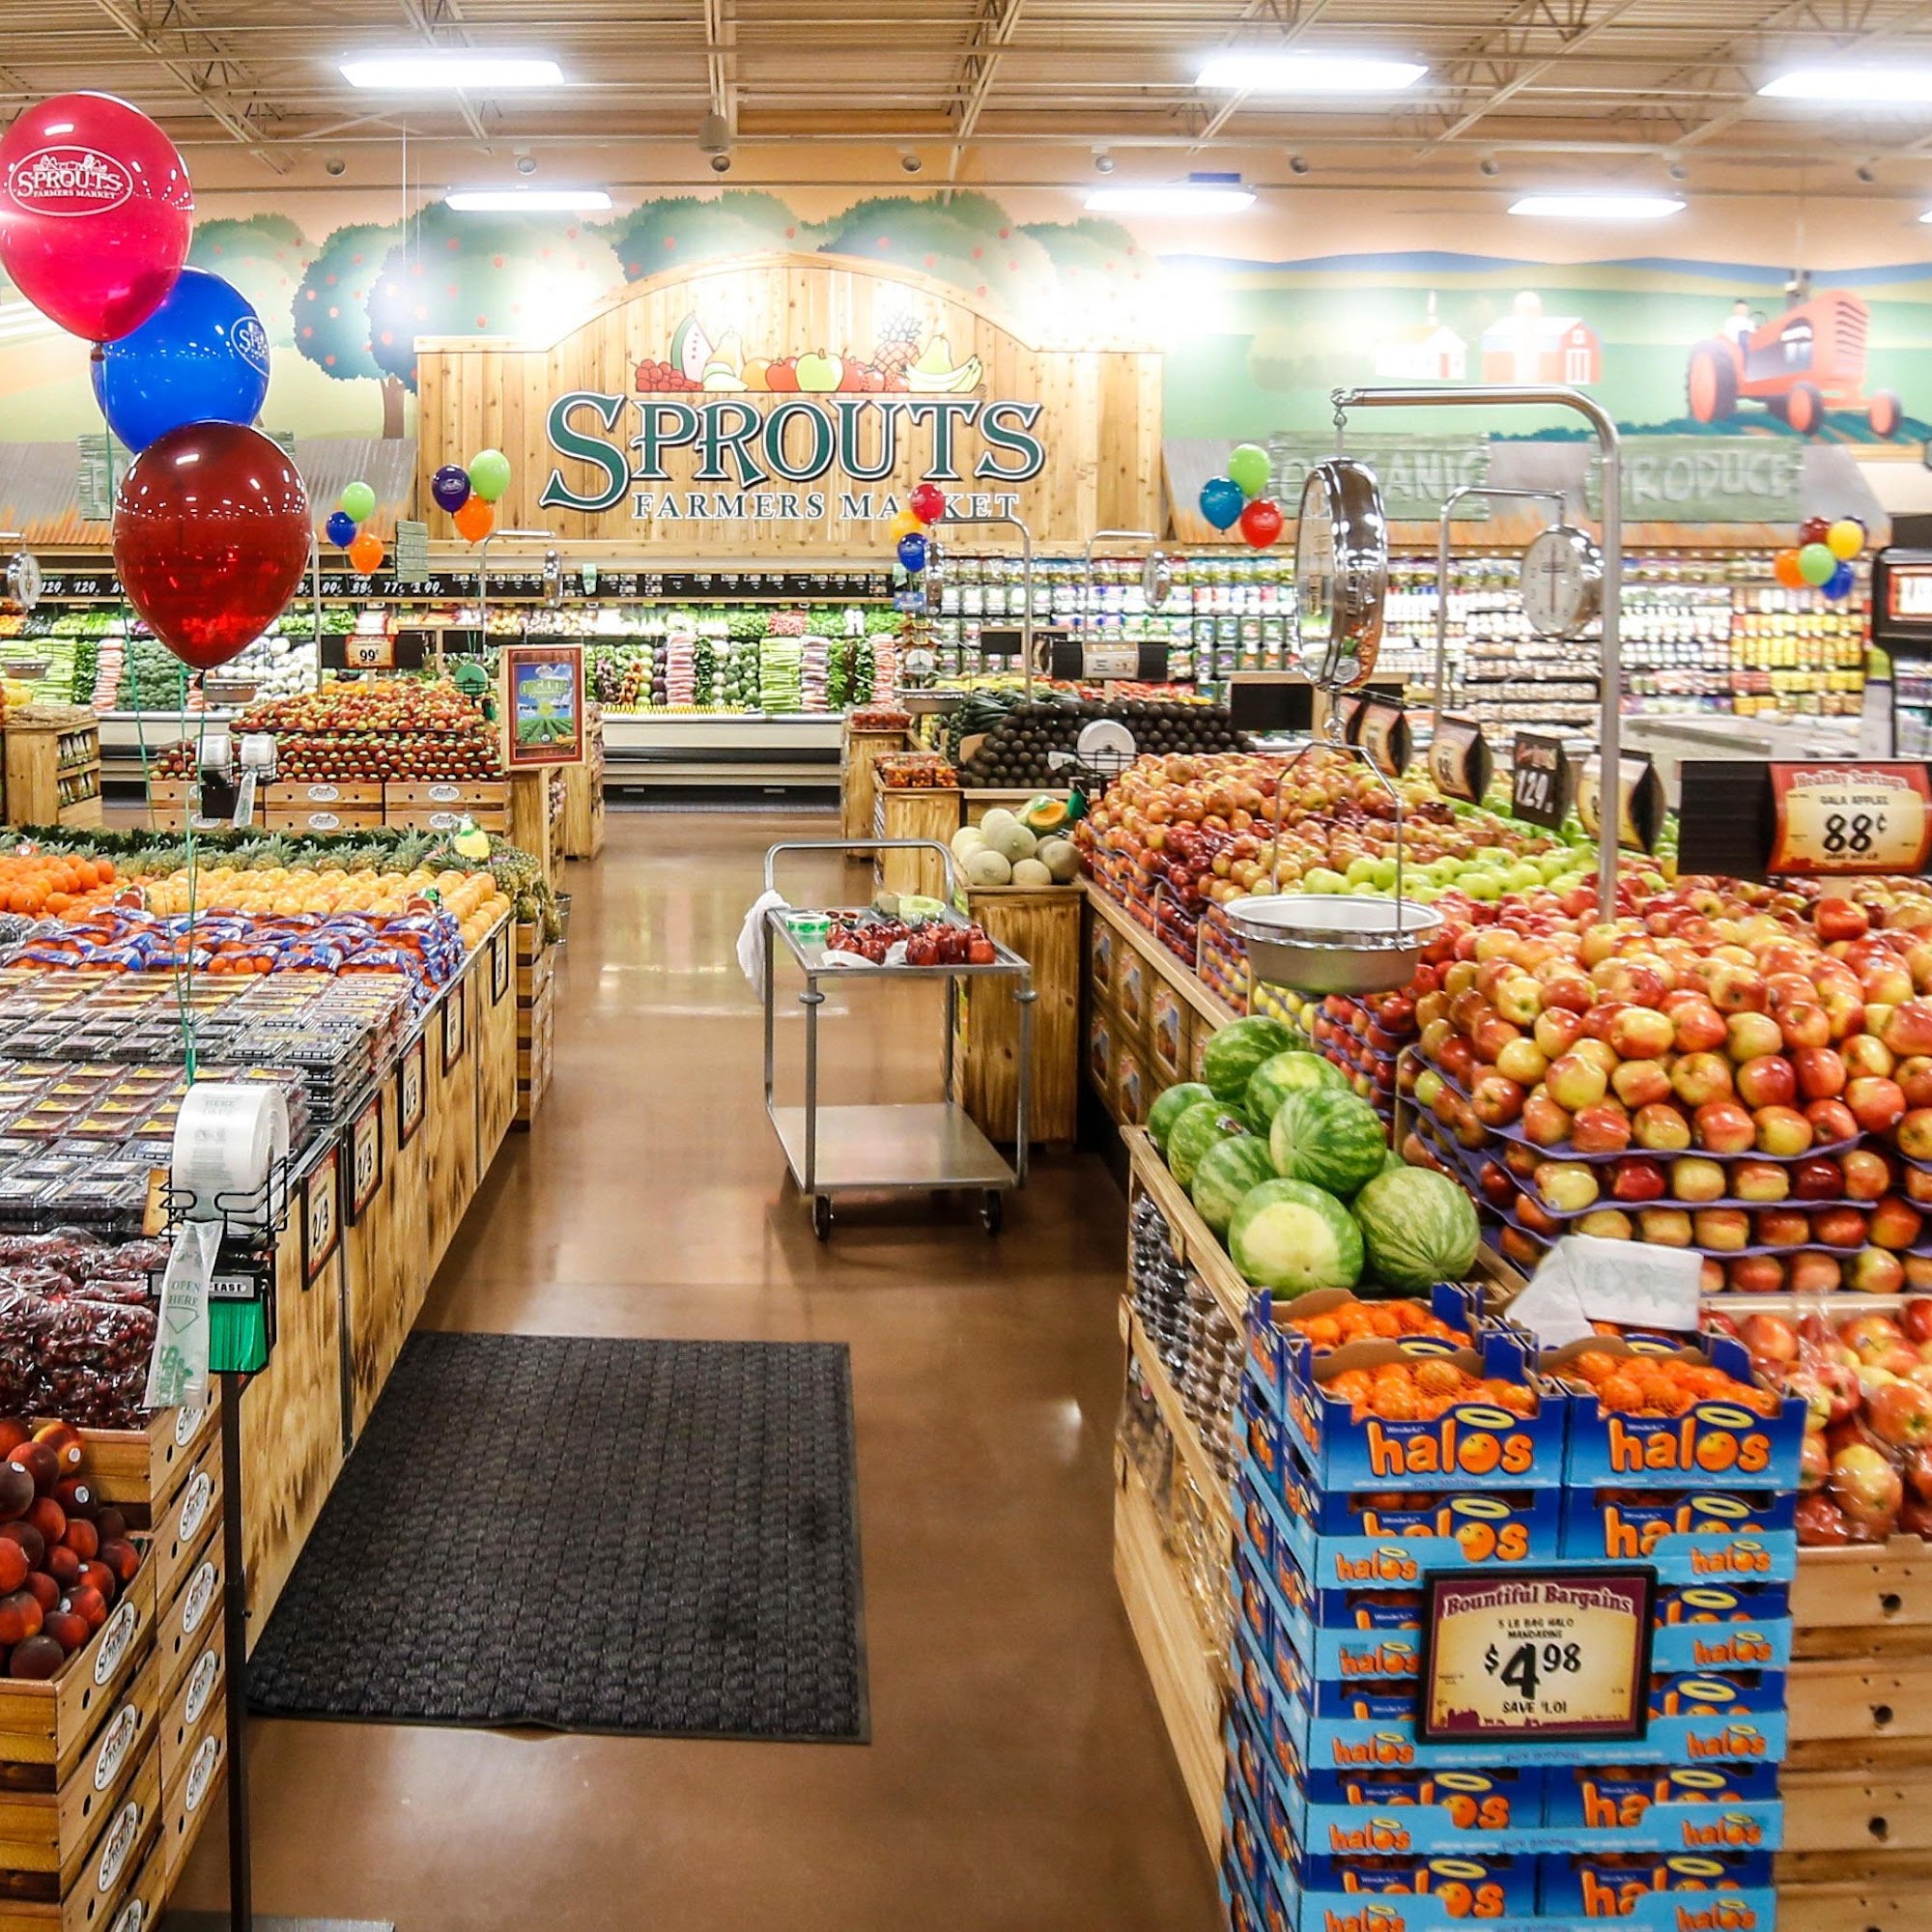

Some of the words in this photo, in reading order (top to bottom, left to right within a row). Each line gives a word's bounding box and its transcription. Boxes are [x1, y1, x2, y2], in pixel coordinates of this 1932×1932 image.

[17, 170, 124, 197] SPROUTS
[34, 188, 74, 198] FARMERS
[76, 189, 116, 200] MARKET
[539, 391, 1045, 512] SPROUTS
[632, 492, 824, 520] FARMERS
[839, 492, 1019, 520] MAKET
[1822, 812, 1888, 852] 88¢
[169, 1294, 198, 1305] HERE
[171, 1280, 201, 1292] OPEN
[1367, 1418, 1533, 1477] halos
[1607, 1415, 1772, 1473] halos
[1335, 1551, 1418, 1581] halos
[1690, 1547, 1771, 1576] halos
[1444, 1584, 1538, 1617] Bountiful
[1545, 1583, 1634, 1614] Bargains
[1507, 1630, 1563, 1639] MANDARINS
[1548, 1618, 1575, 1628] HALO
[1340, 1645, 1421, 1676] halos
[1694, 1637, 1773, 1666] halos
[1502, 1701, 1535, 1714] SAVE
[1332, 1737, 1414, 1765] halos
[1687, 1730, 1768, 1758] halos
[1328, 1822, 1411, 1852] halos
[1682, 1818, 1763, 1848] halos
[1324, 1908, 1406, 1932] halos
[1676, 1903, 1756, 1932] halos
